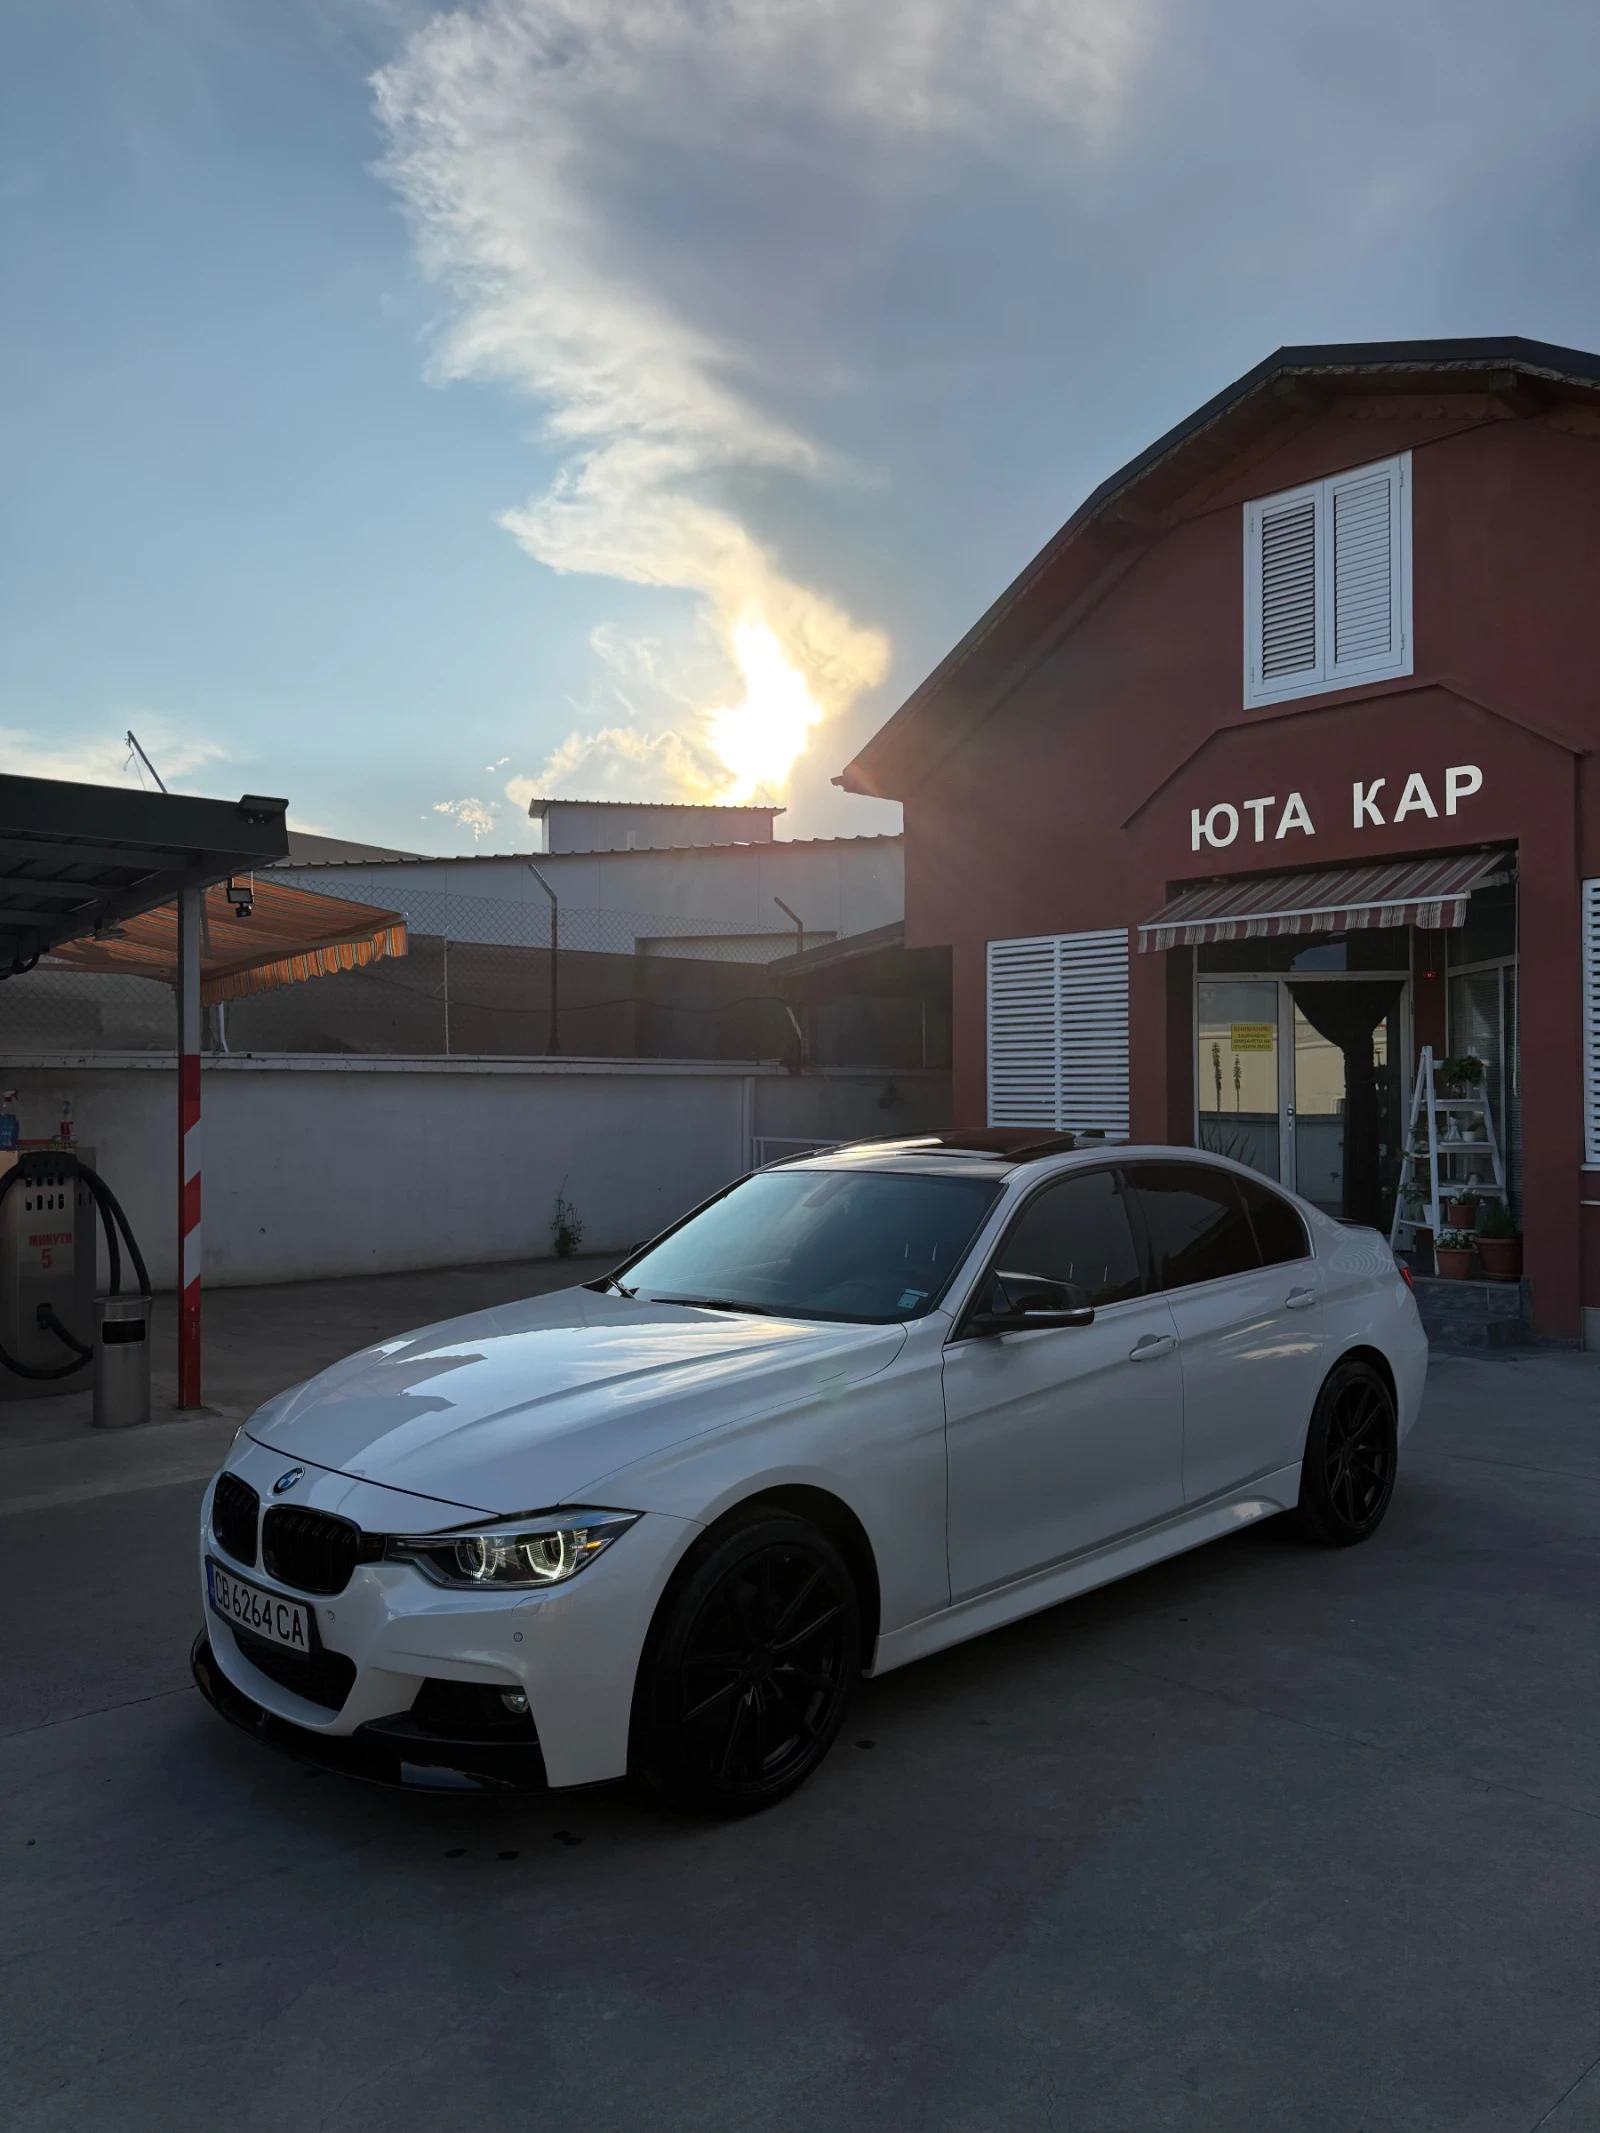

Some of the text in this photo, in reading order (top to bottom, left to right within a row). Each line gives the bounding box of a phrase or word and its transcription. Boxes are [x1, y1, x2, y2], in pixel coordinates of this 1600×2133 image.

[1191, 764, 1484, 851] ЮТА КАР
[29, 1232, 72, 1247] МИНУТИ
[41, 1248, 52, 1269] 5
